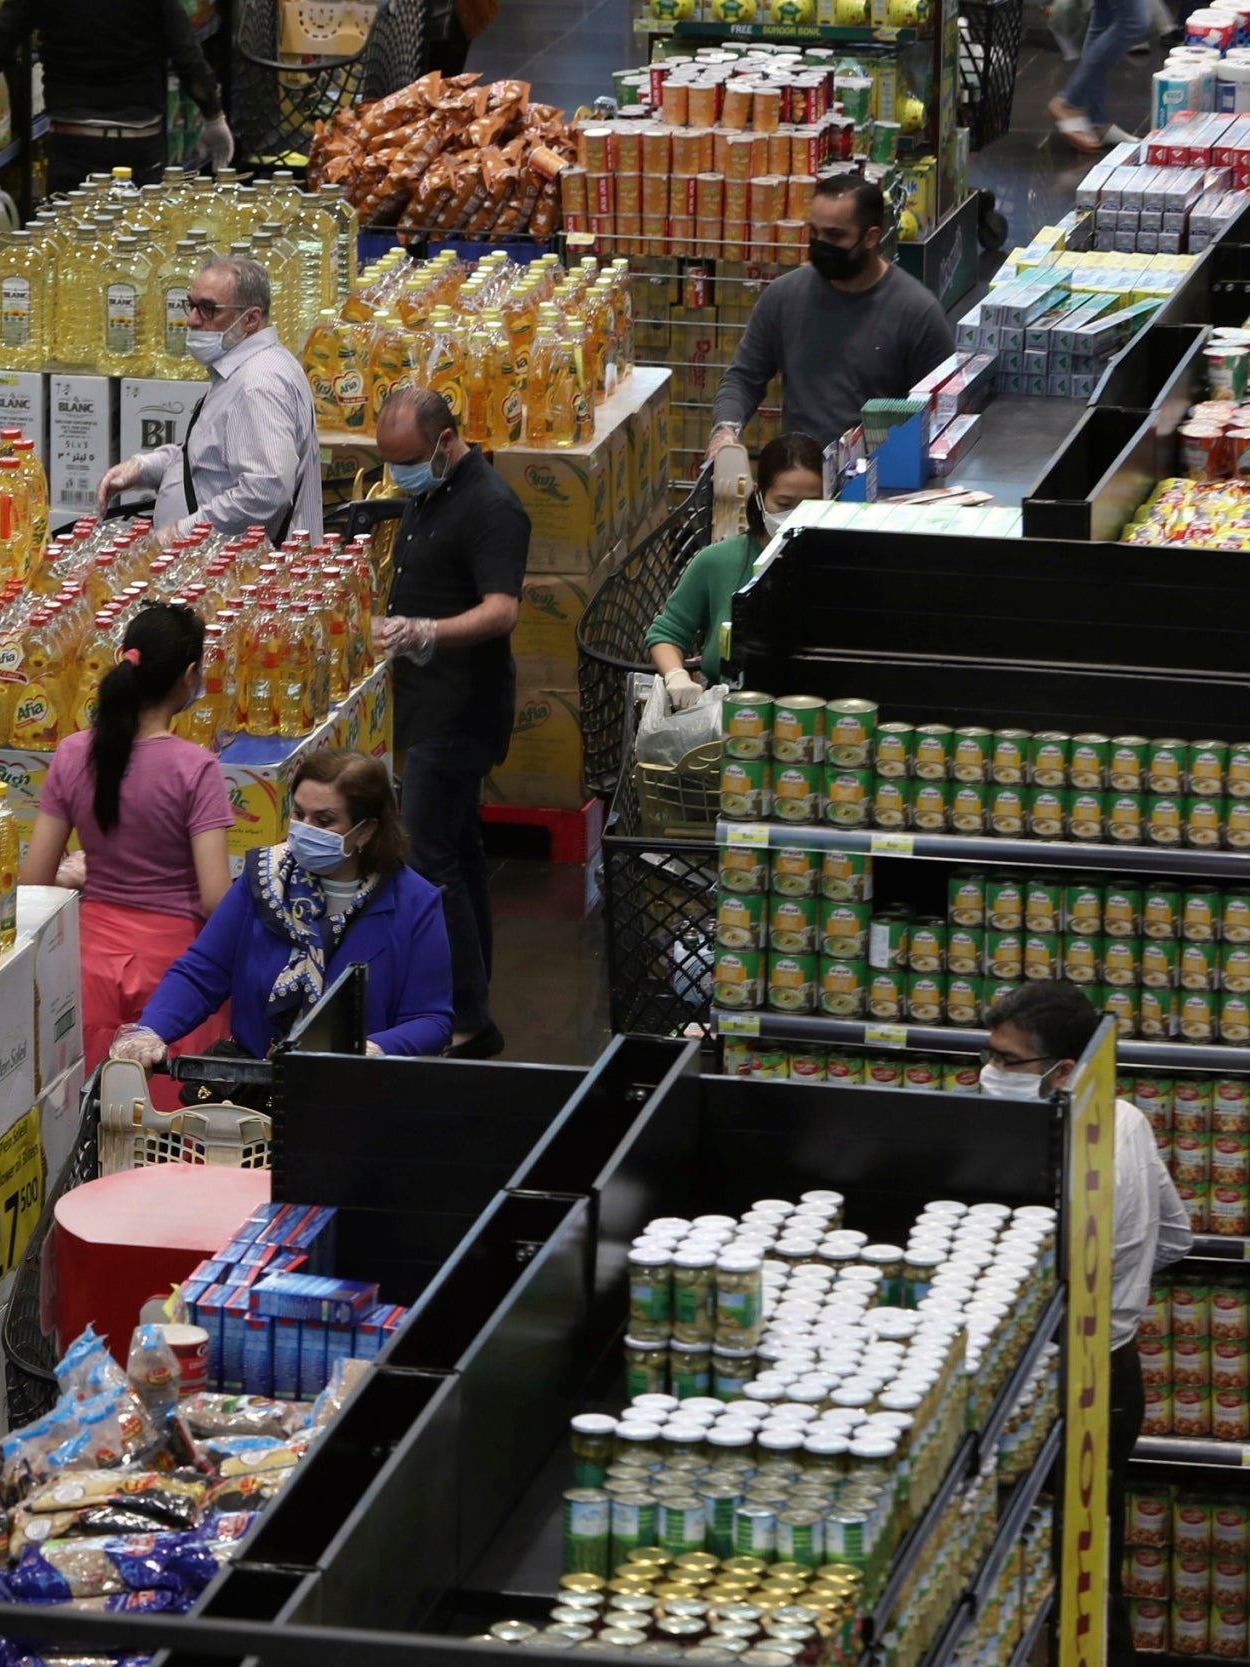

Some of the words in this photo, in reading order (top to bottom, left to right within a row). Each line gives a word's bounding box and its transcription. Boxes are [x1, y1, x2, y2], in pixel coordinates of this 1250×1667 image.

[730, 24, 753, 35] FREE
[3, 291, 29, 299] BLANC
[109, 298, 133, 306] BLANC
[340, 381, 358, 394] Afia
[58, 401, 95, 414] BLANC
[17, 702, 44, 721] Afia
[20, 1176, 39, 1215] 500
[1075, 1102, 1102, 1667] motion
